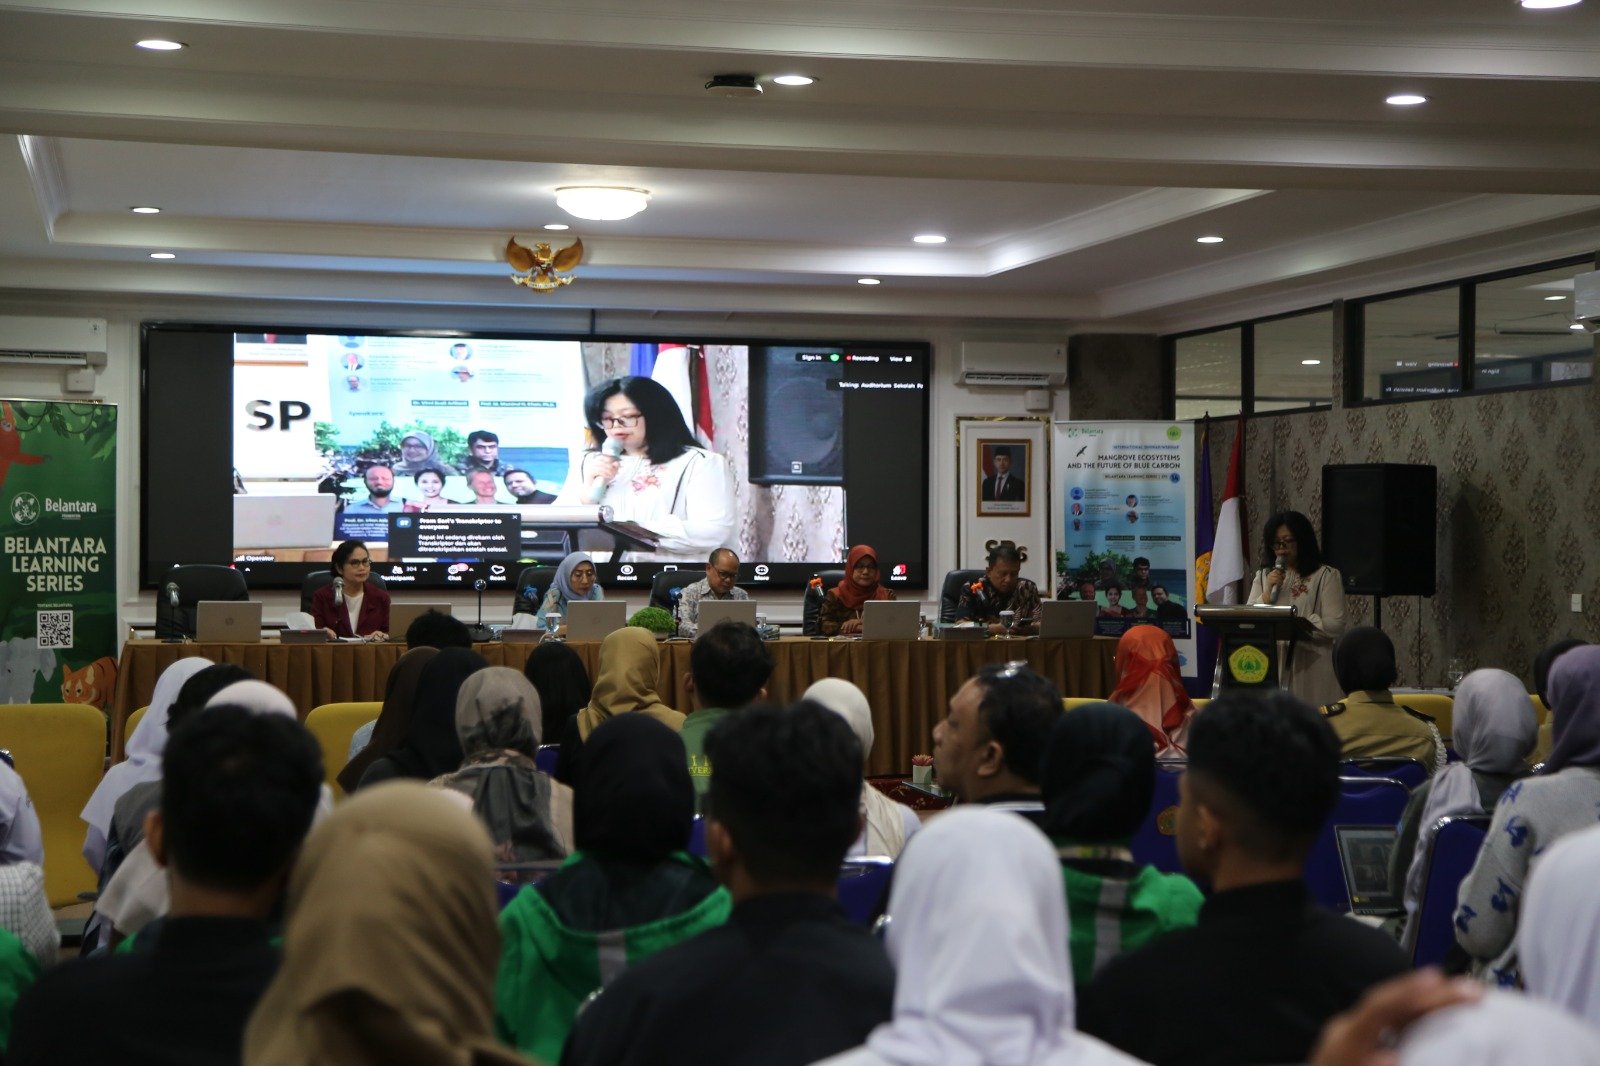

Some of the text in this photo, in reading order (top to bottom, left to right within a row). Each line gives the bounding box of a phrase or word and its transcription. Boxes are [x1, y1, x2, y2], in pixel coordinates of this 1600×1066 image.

[45, 498, 97, 512] Belantara
[5, 537, 106, 554] BELANTARA
[12, 556, 99, 573] LEARNING
[27, 575, 83, 592] SERIES
